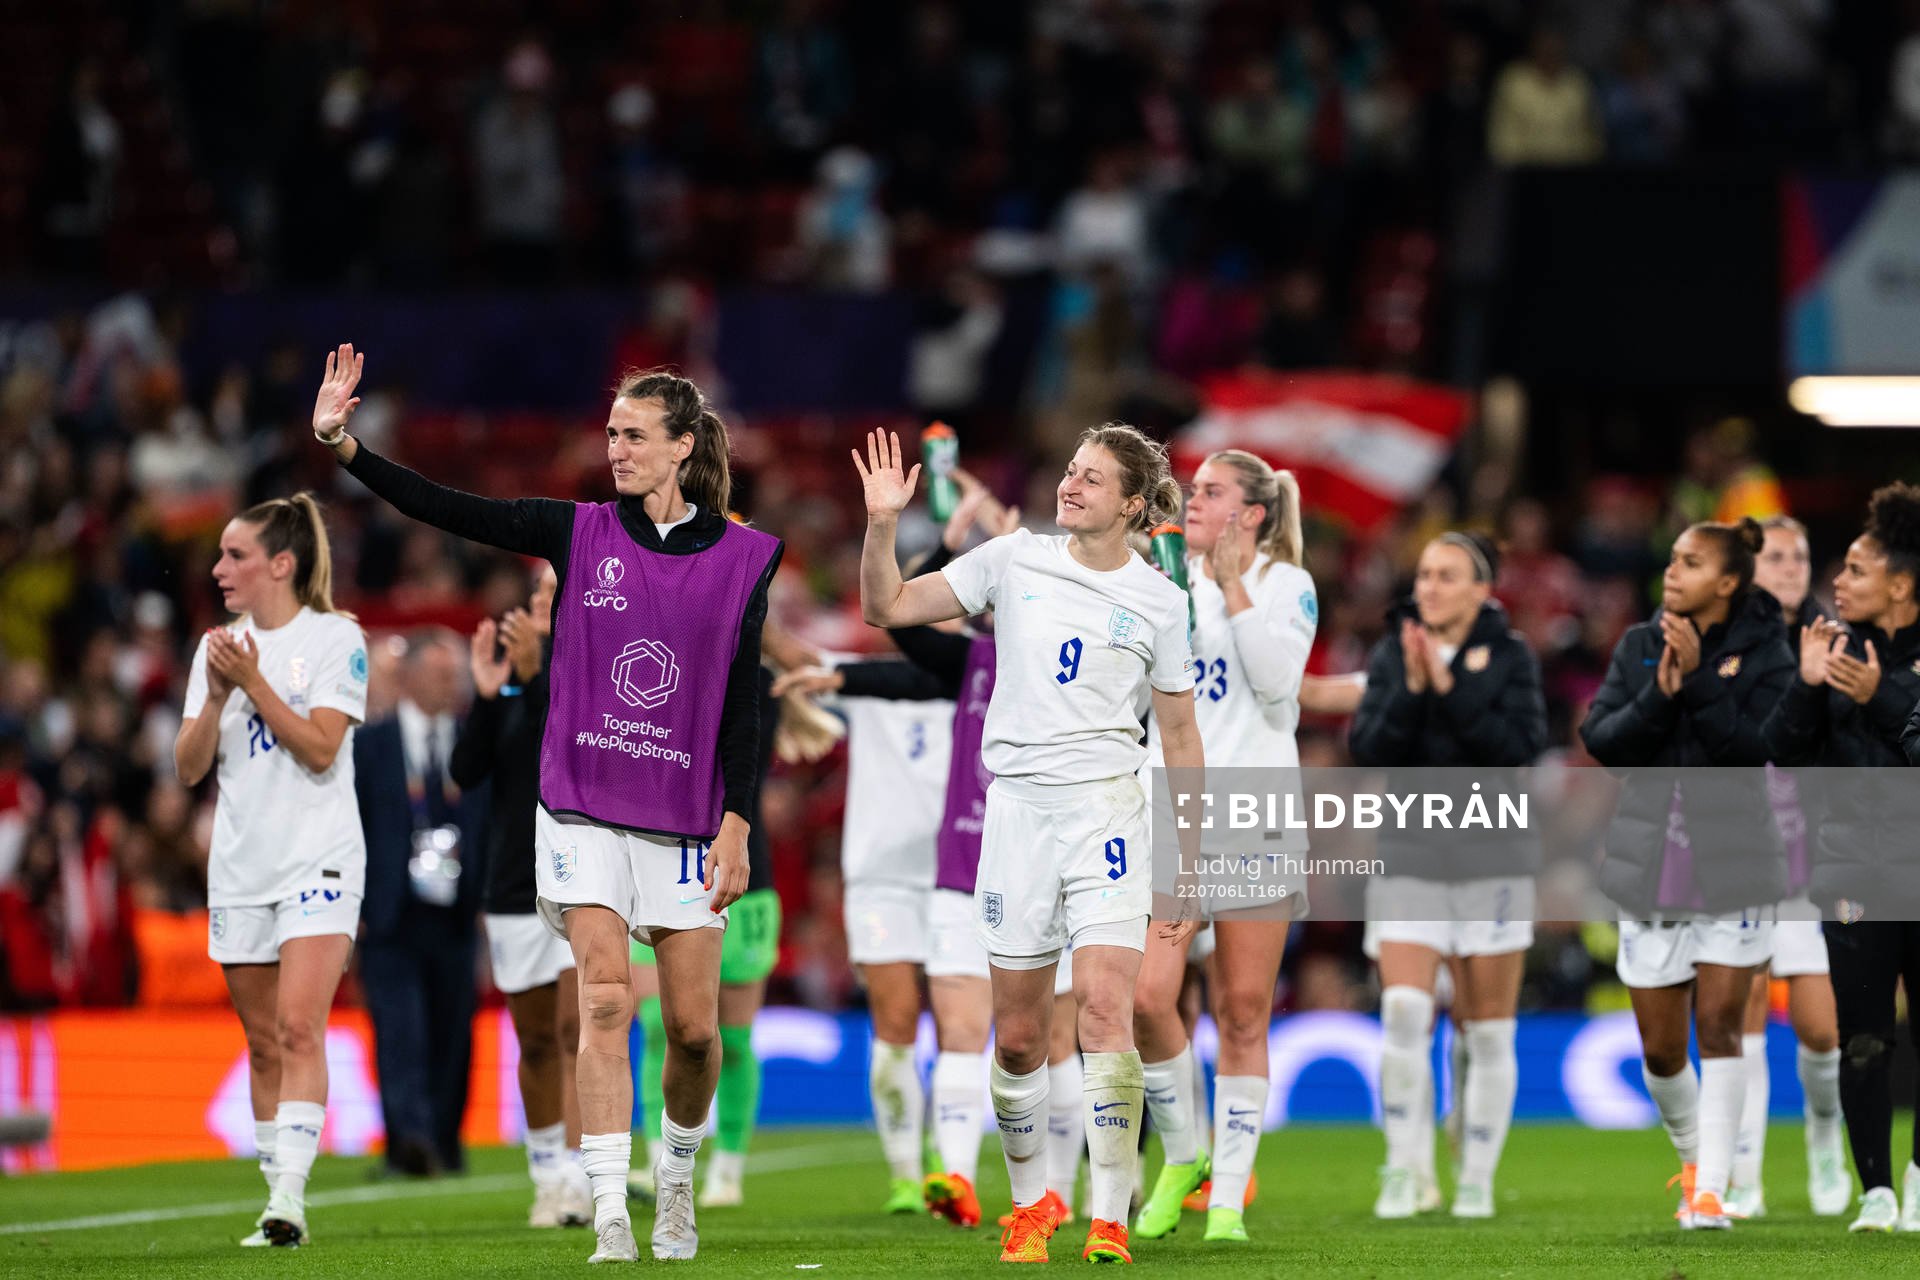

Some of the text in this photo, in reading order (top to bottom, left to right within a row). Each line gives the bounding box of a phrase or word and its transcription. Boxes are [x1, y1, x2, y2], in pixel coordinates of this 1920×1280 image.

[1056, 637, 1084, 685] 9
[602, 713, 673, 739] Together
[575, 731, 692, 769] #WePlayStrong
[1104, 837, 1127, 881] 9
[1094, 1114, 1130, 1129] Eng
